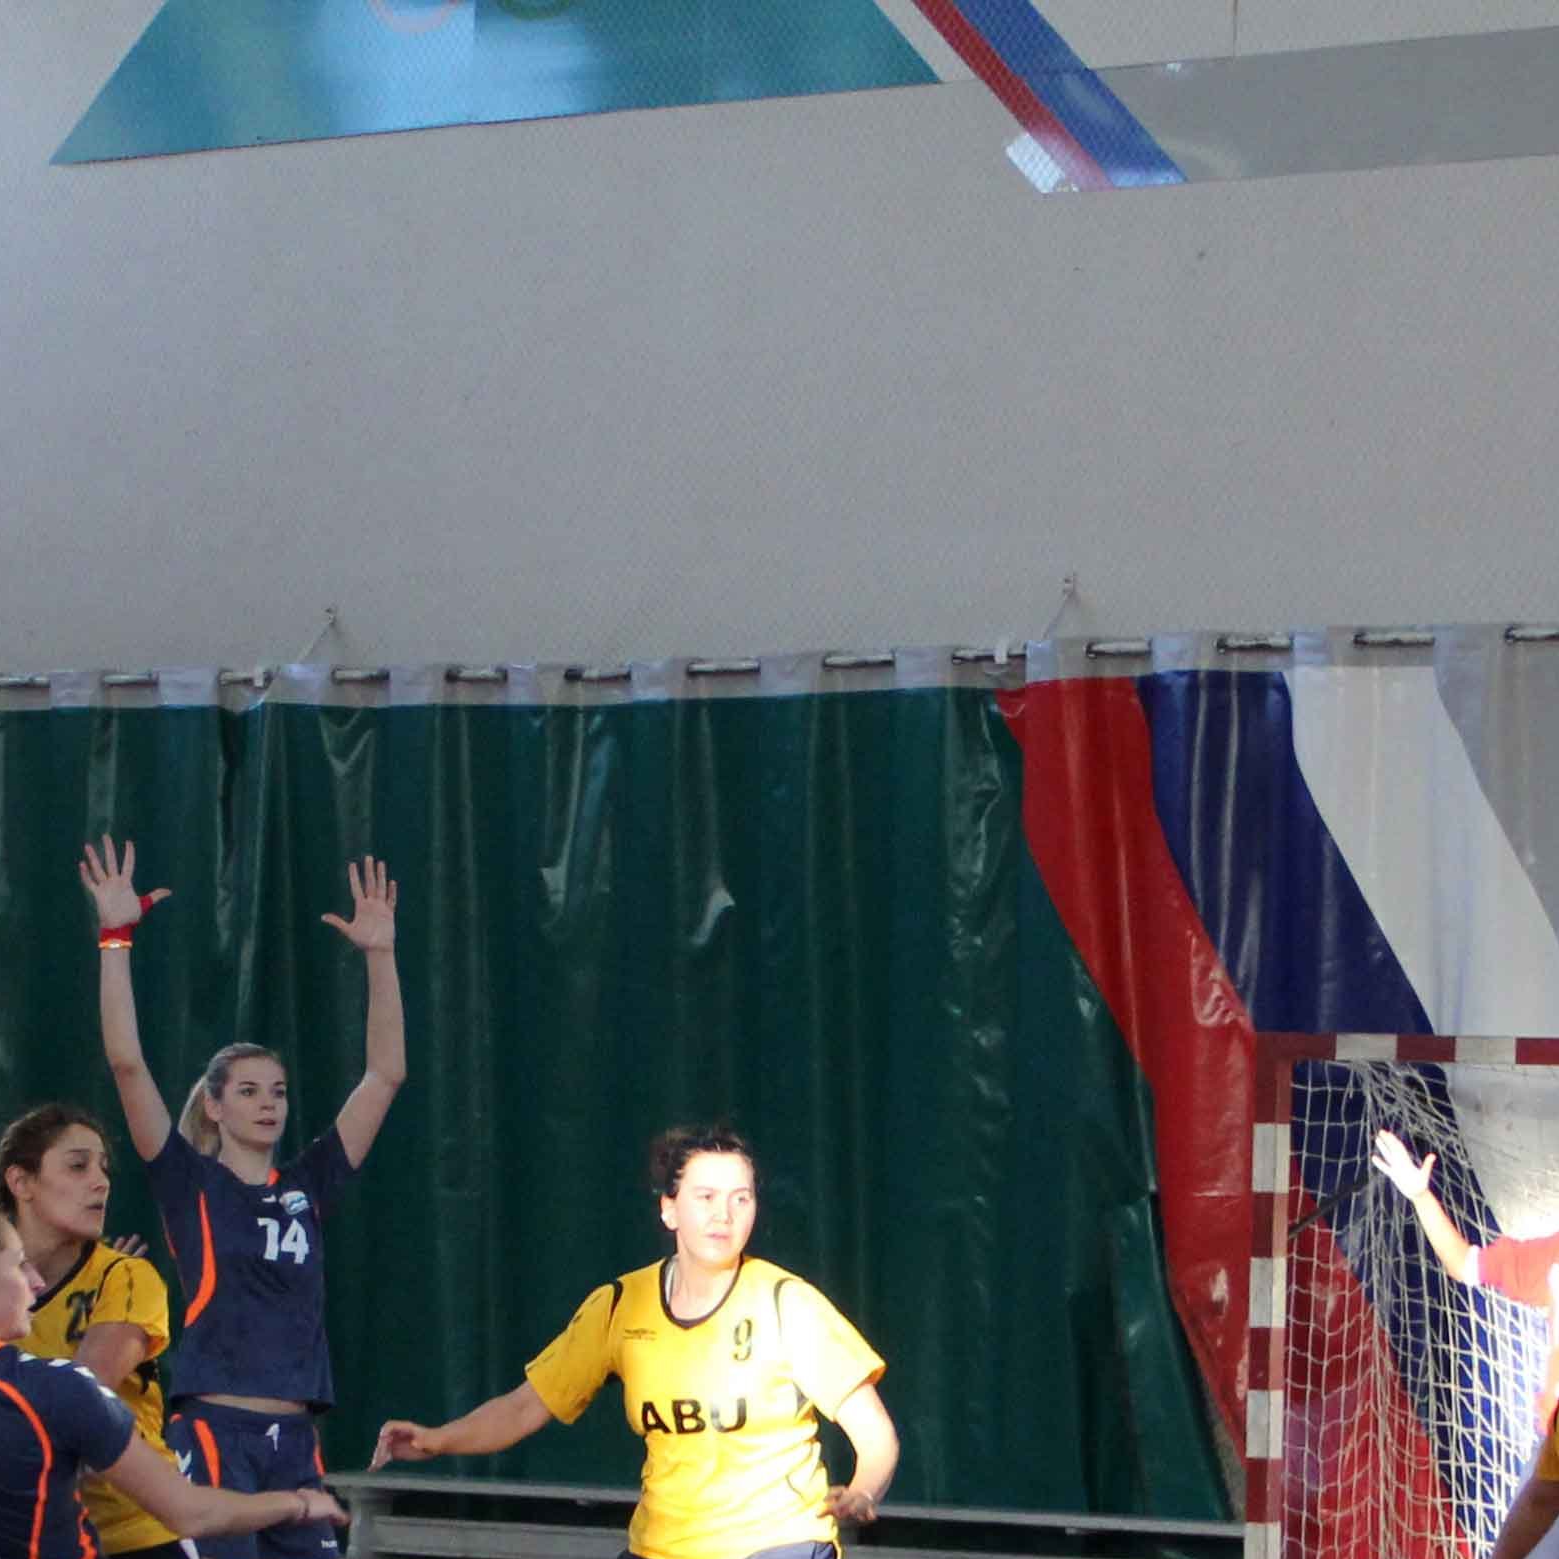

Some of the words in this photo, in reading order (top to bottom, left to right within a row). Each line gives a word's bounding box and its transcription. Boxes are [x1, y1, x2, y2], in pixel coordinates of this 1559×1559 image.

[256, 1217, 309, 1265] 14
[732, 1318, 753, 1361] 9
[641, 1397, 747, 1434] ABU
